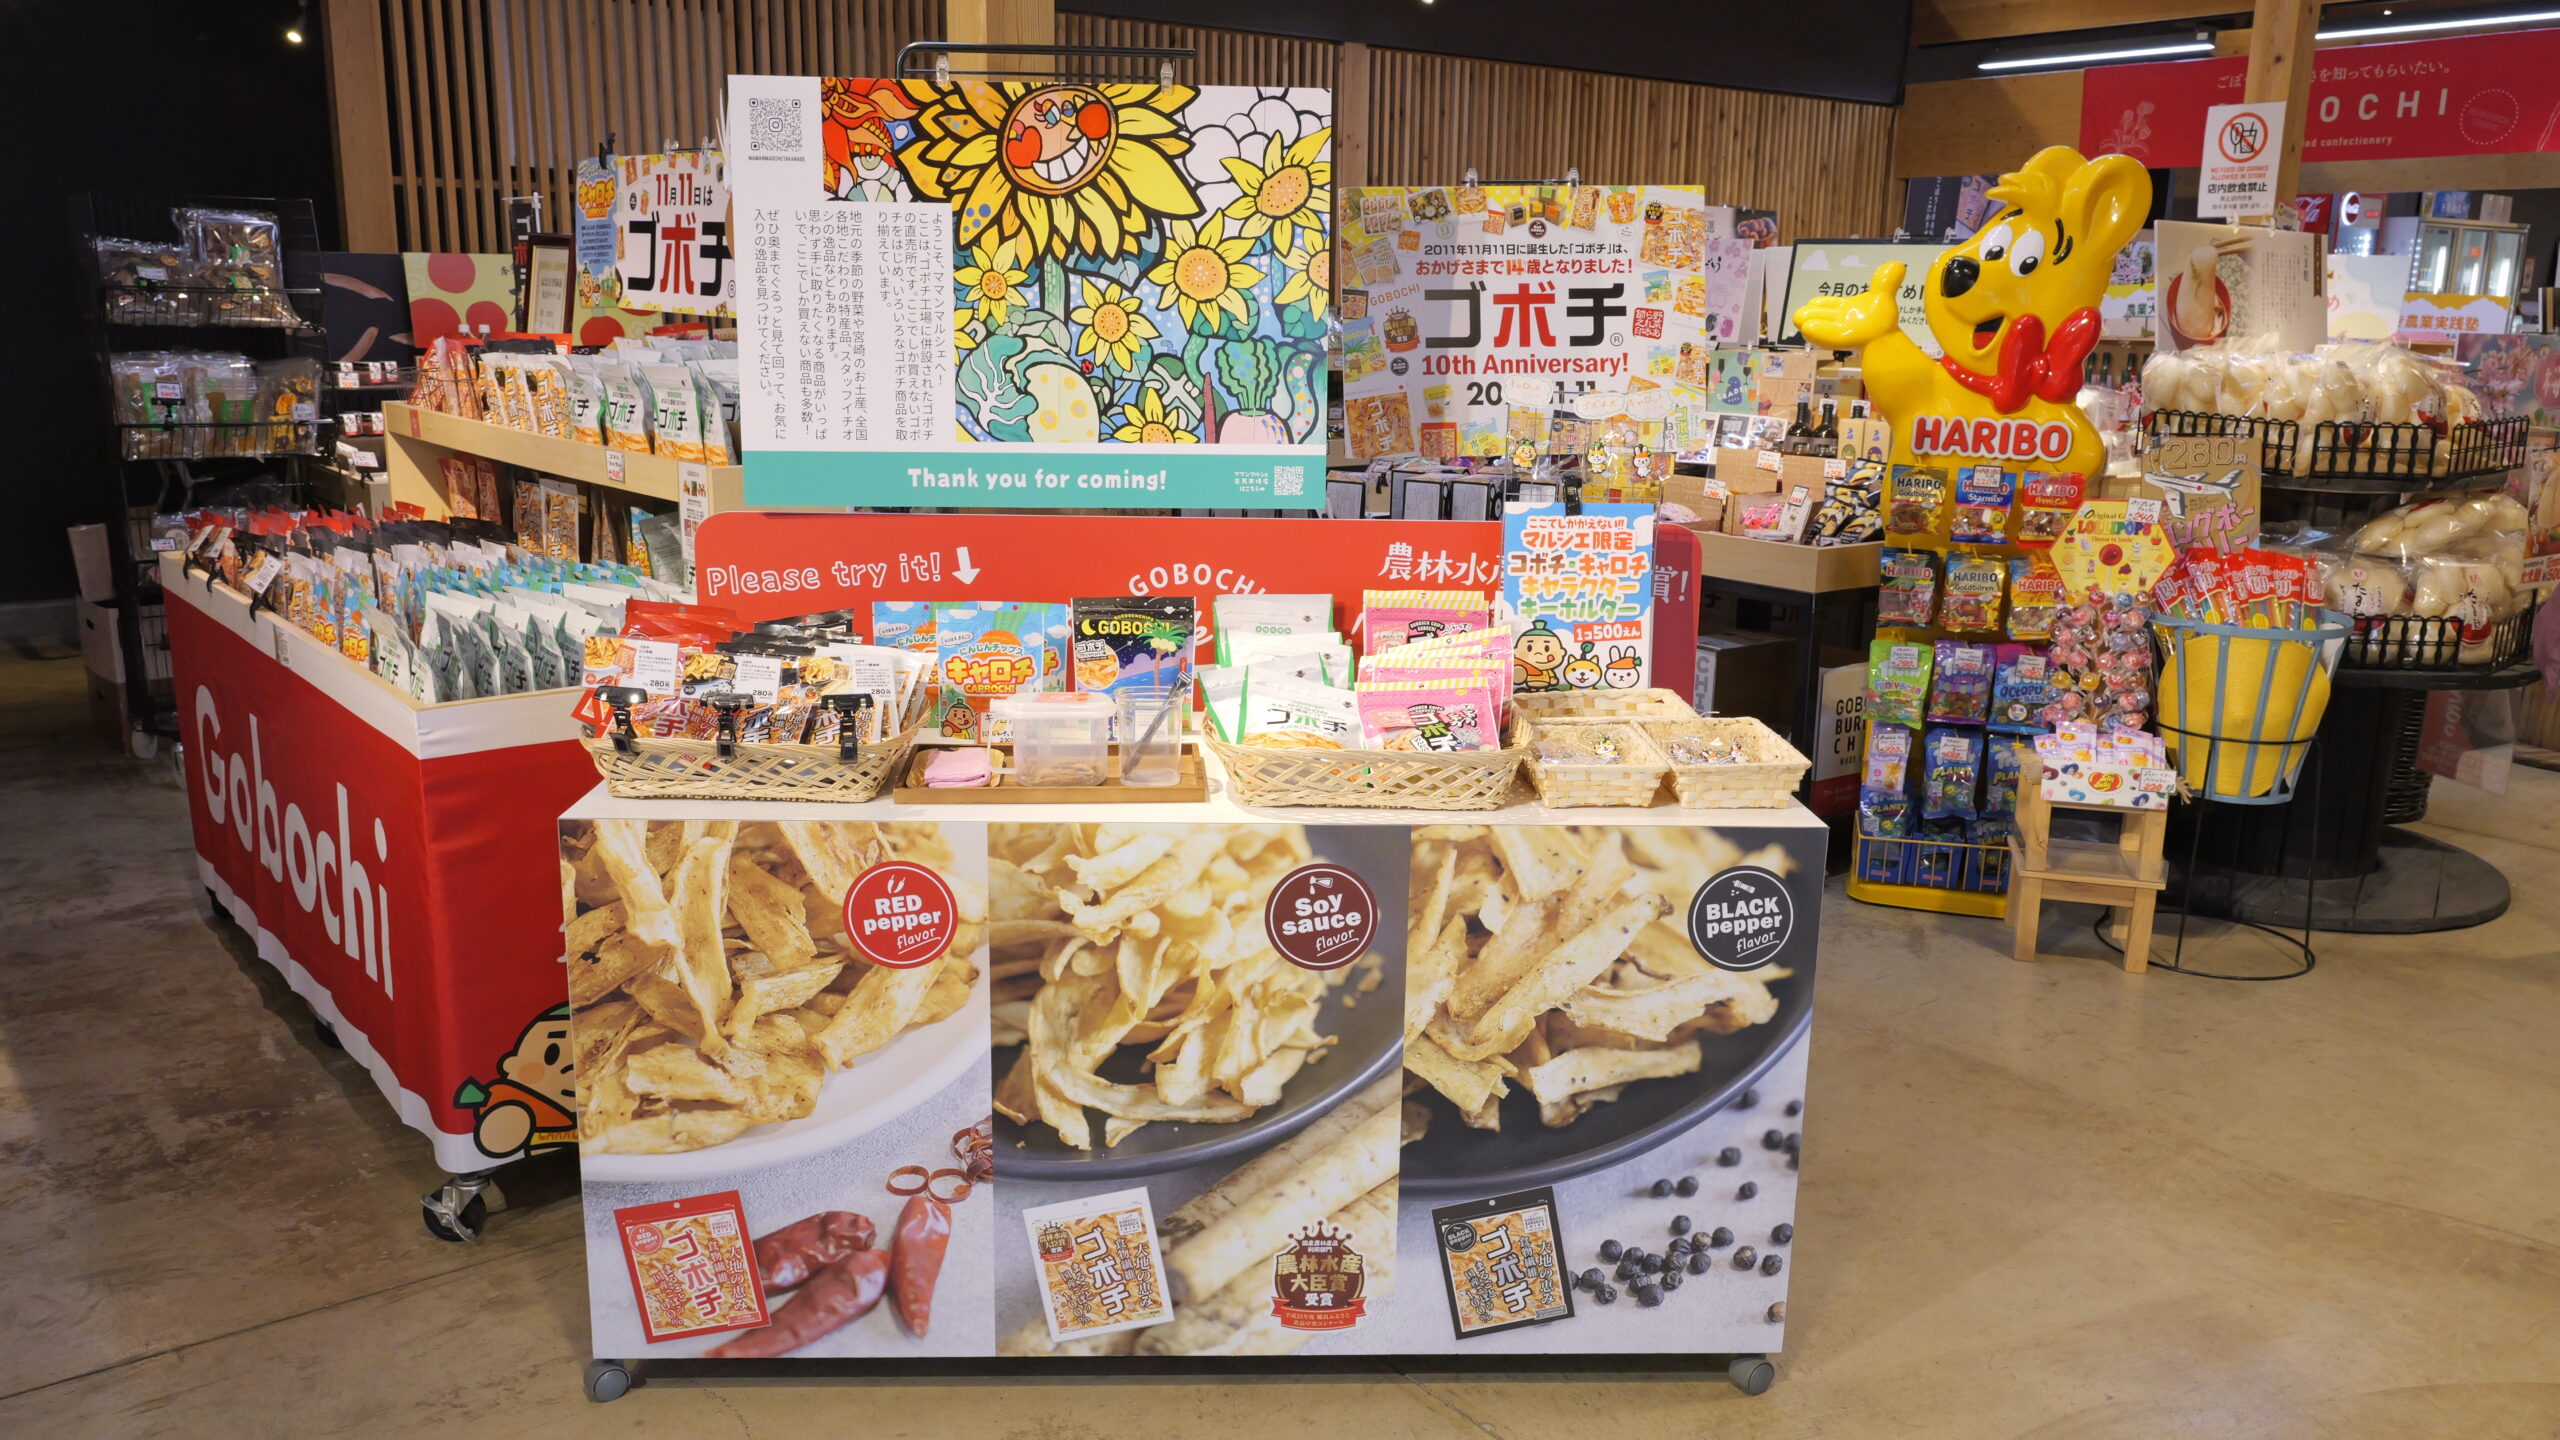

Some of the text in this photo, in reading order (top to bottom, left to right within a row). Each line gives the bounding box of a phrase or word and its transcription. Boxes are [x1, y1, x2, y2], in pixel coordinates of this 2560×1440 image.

[2319, 87, 2449, 123] OCHI
[656, 173, 713, 206] 11月11日は
[2207, 181, 2268, 194] 店内飲食禁止
[628, 210, 734, 297] ゴボチ
[1424, 243, 1629, 256] 2011年11月11日に誕生した「ゴボチ」は、
[1416, 258, 1633, 276] おかげさまで14歳となりました！
[1369, 282, 1421, 307] GOBOCHI
[1424, 279, 1627, 348] ゴボチ
[2400, 314, 2480, 331] 農業実践塾
[1422, 352, 1629, 378] 10th Anniversary!
[658, 407, 688, 432] ゴボチ
[1913, 415, 2071, 459] HARIBO
[2165, 439, 2248, 470] 280円
[907, 466, 1168, 493] Thank you for coming!
[1896, 477, 1942, 490] HARIBO
[2028, 483, 2079, 498] HARIBO
[1967, 492, 2004, 503] Starmix
[2085, 509, 2117, 520] Original
[706, 551, 942, 597] Please try it!
[1886, 565, 1933, 579] HARIBO
[1953, 571, 1998, 583] HARIBO
[1521, 577, 1639, 598] キャラクター
[1954, 583, 1994, 592] Goldbären
[2017, 579, 2064, 592] HARIBO
[1520, 596, 1638, 620] キーホルダー
[1575, 623, 1641, 642] 1コ500えん
[960, 642, 1024, 656] にんじんチップス
[1074, 638, 1106, 653] ゴボチ
[945, 655, 1035, 685] キャロチ
[649, 679, 670, 688] 280円
[752, 689, 773, 697] 280円
[964, 683, 1017, 694] CARROCHI
[195, 684, 394, 1001] Gobochi
[874, 894, 923, 916] RED
[1294, 893, 1343, 917] Soy
[1706, 896, 1780, 921] BLACK
[863, 910, 942, 936] pepper
[1281, 911, 1362, 936] sauce
[1706, 914, 1783, 939] pepper
[896, 927, 937, 950] flavor
[1315, 929, 1355, 952] flavor
[1736, 931, 1776, 953] flavor
[1115, 1237, 1136, 1281] 食物繊維
[1277, 1254, 1362, 1275] 農林水産
[1479, 1223, 1533, 1314] ゴボチ
[1517, 1235, 1539, 1279] 食物繊維
[667, 1228, 723, 1319] ゴボチ
[727, 1246, 748, 1311] 大地の恵み
[1074, 1226, 1131, 1317] ゴボチ
[1135, 1243, 1155, 1308] 大地の恵み
[1290, 1273, 1348, 1293] 大臣賞
[1538, 1240, 1556, 1305] 大地の恵み
[1304, 1292, 1334, 1307] 受賞
